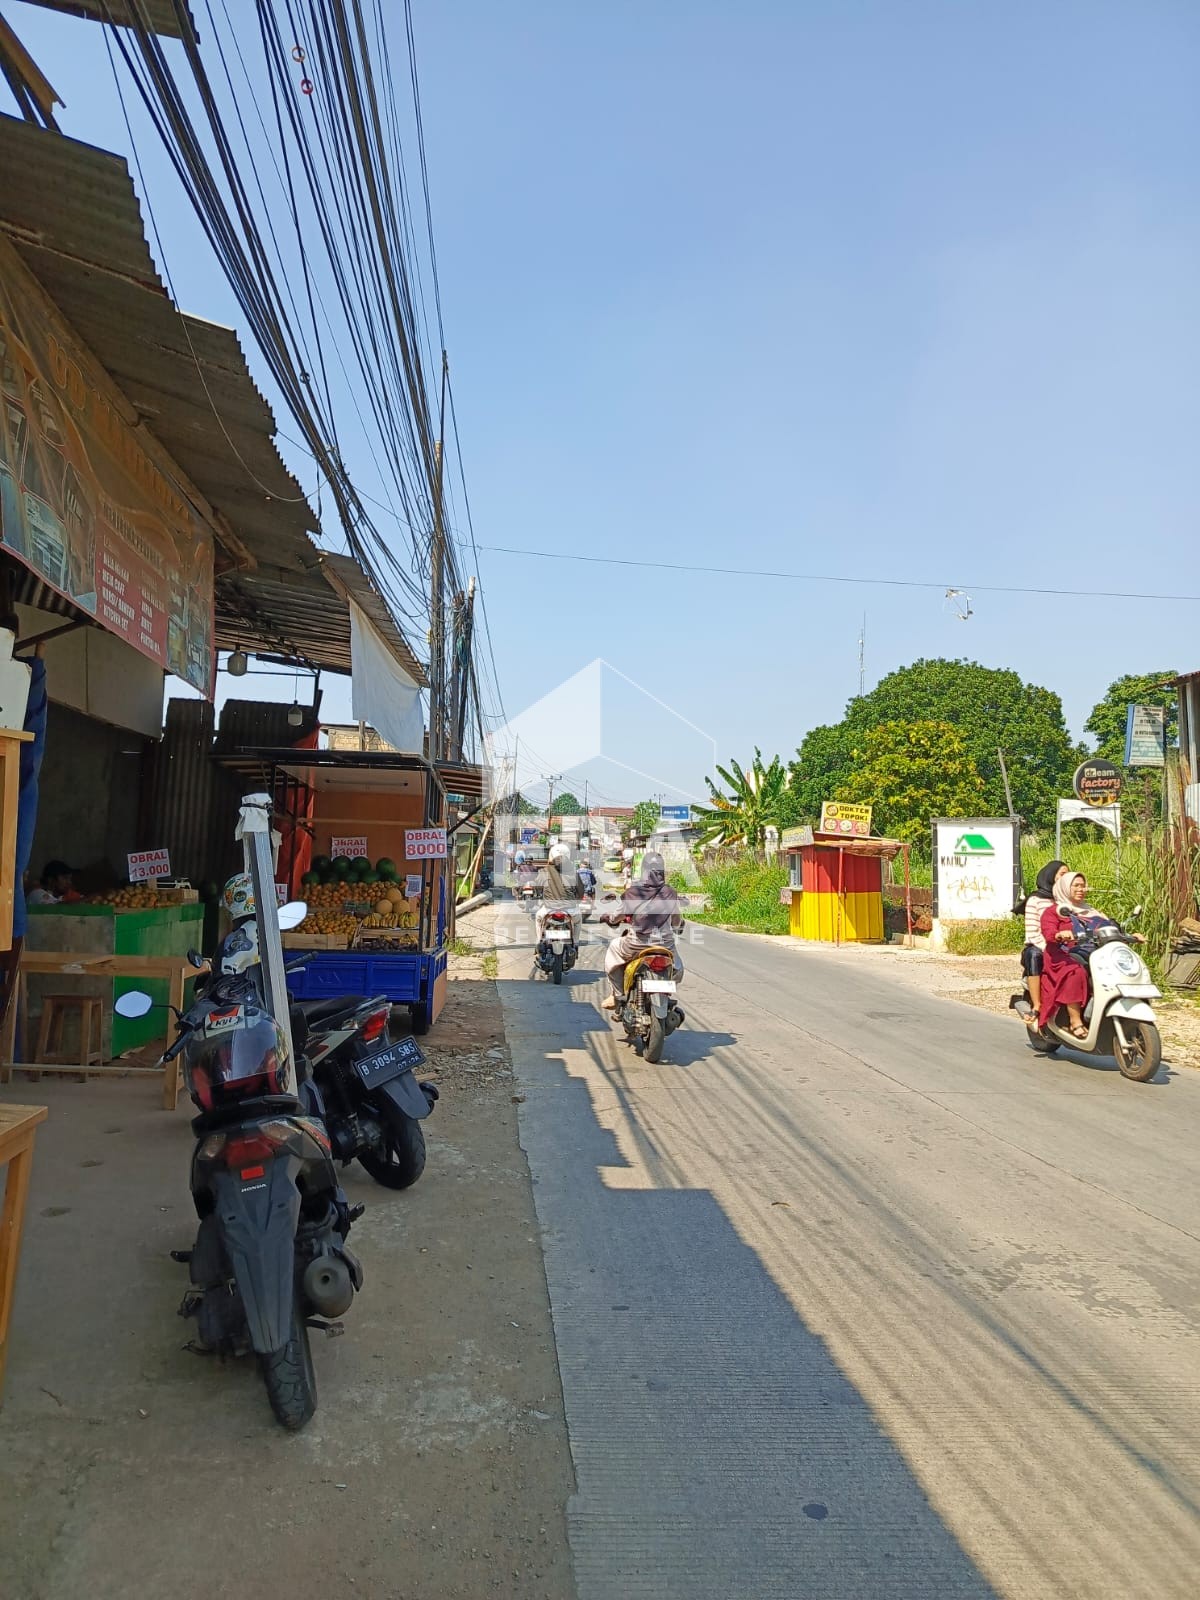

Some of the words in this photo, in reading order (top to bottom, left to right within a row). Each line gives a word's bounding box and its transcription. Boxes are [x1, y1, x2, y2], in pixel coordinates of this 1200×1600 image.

[1081, 777, 1120, 789] factory
[406, 832, 445, 842] OBRAL
[407, 843, 446, 856] 8000
[130, 851, 168, 864] OBRAL
[132, 863, 169, 878] 13.000
[361, 1064, 370, 1076] B
[372, 1051, 396, 1070] 3094
[398, 1042, 415, 1057] SBS
[241, 1183, 266, 1192] HONDA
